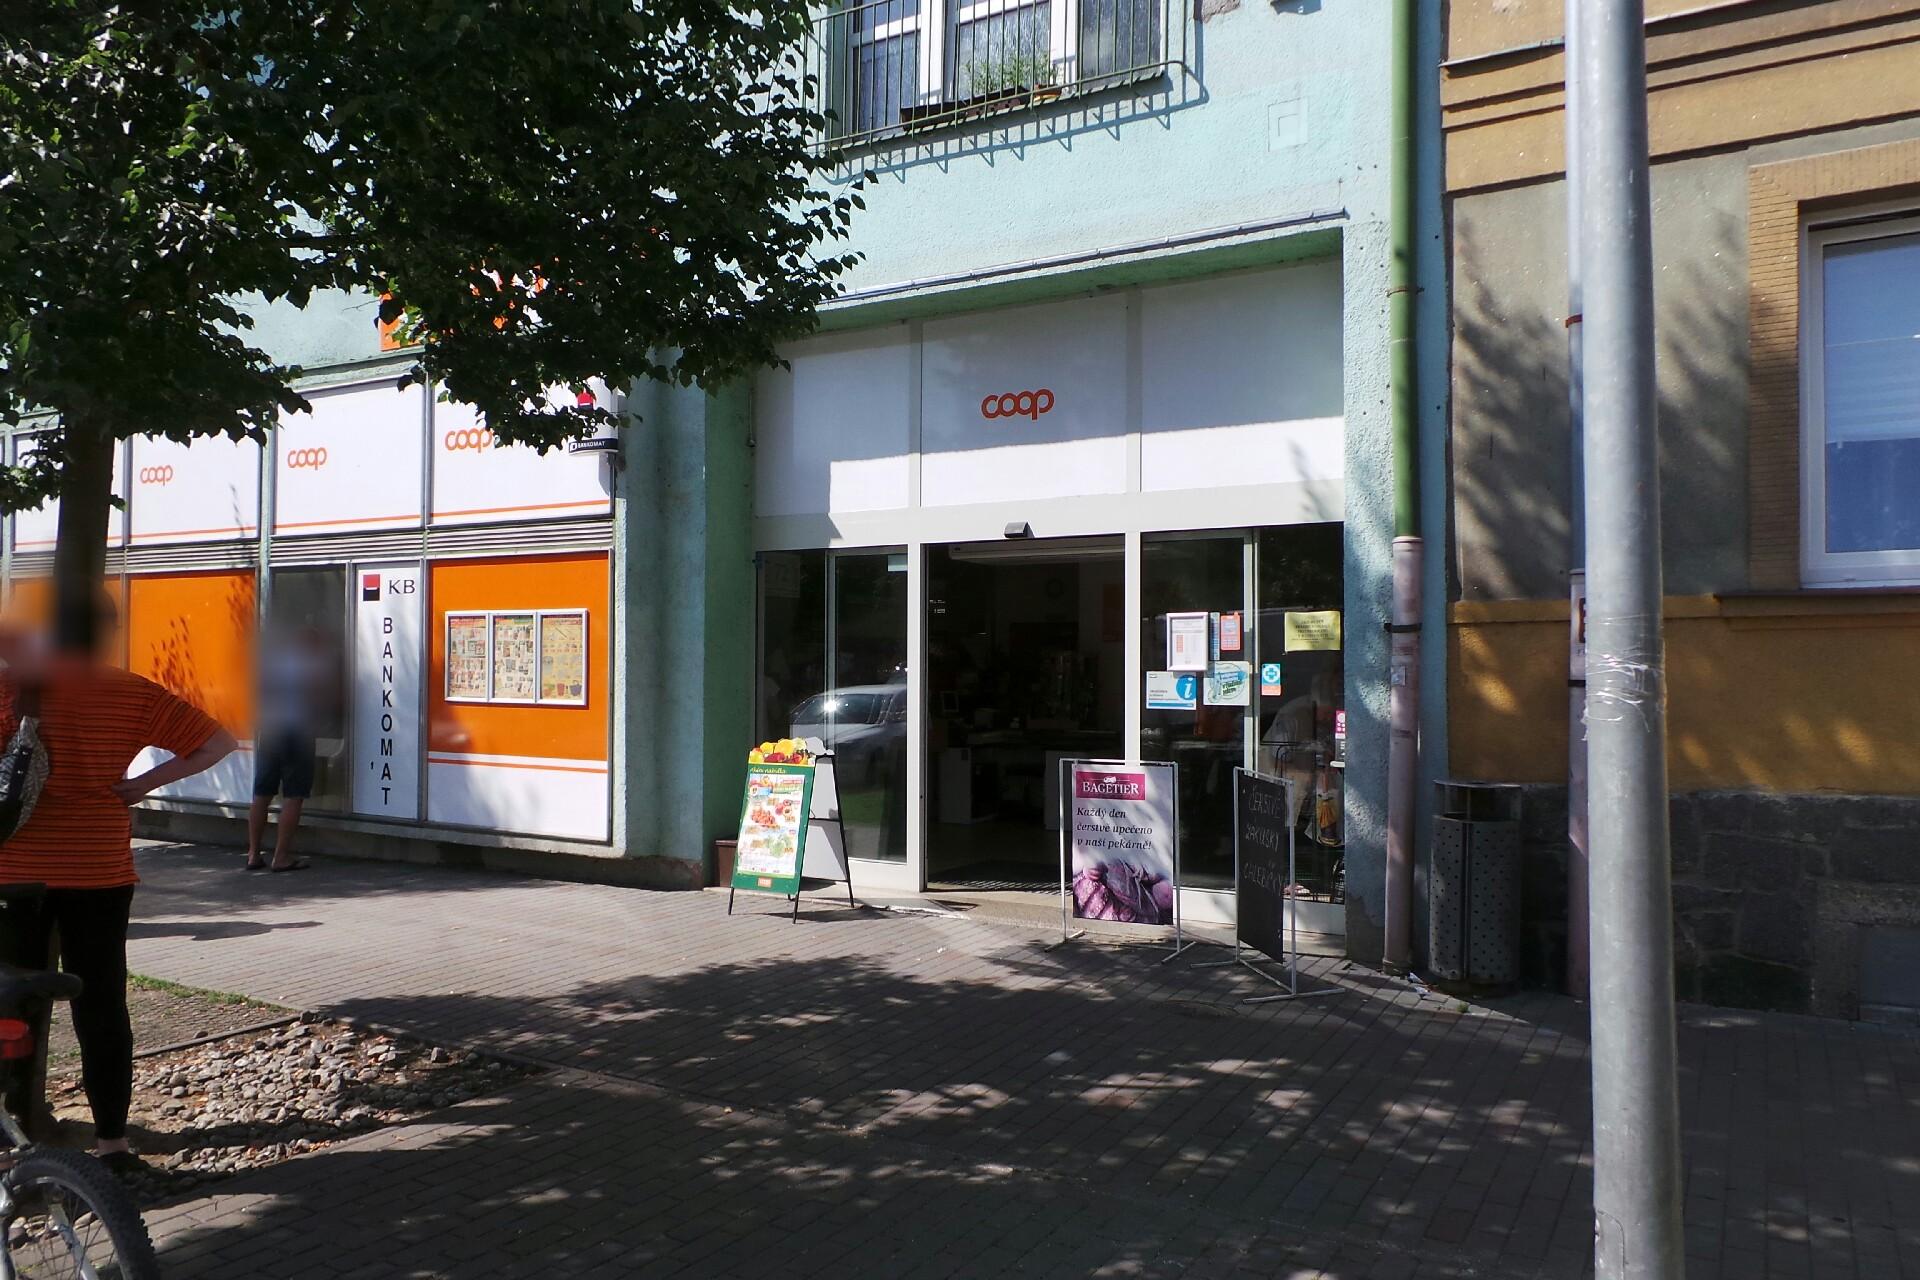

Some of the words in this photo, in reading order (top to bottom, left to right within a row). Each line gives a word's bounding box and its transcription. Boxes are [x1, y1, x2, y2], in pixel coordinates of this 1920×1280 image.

[981, 388, 1055, 421] coop
[445, 427, 494, 453] coop
[577, 440, 606, 448] BANKOMAT
[287, 447, 327, 470] coop
[140, 465, 173, 486] coop
[388, 579, 416, 594] KB
[380, 616, 394, 806] BANKOMAT
[1082, 781, 1139, 795] BAGETIER
[1076, 807, 1107, 819] Každý
[1108, 808, 1126, 818] den
[1076, 822, 1111, 832] čerstvě
[1112, 823, 1153, 836] upečeno
[1077, 838, 1083, 847] v
[1085, 837, 1106, 847] naší
[1107, 838, 1152, 850] pekárně!
